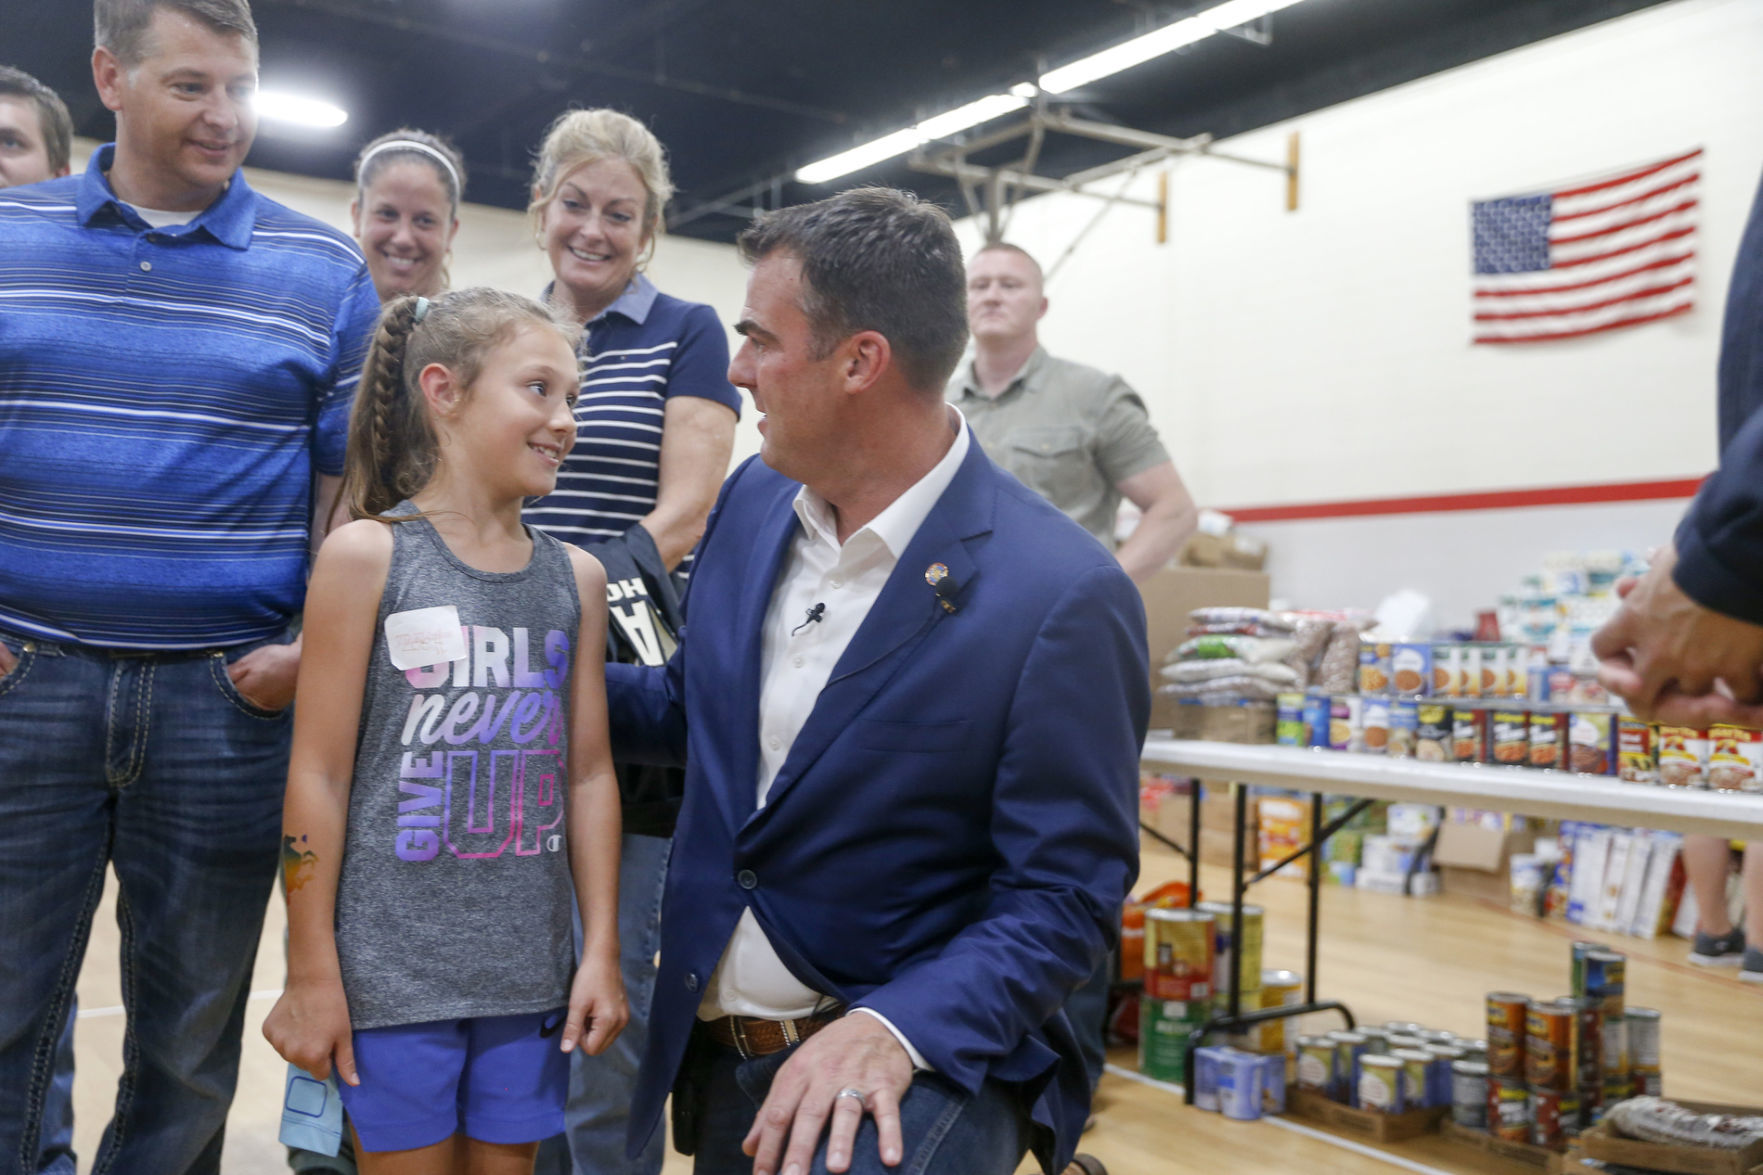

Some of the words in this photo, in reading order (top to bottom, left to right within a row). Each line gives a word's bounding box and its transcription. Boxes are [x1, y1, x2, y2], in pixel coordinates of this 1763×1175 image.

[401, 690, 564, 746] never
[395, 750, 444, 862] GIVE
[443, 749, 565, 859] UP
